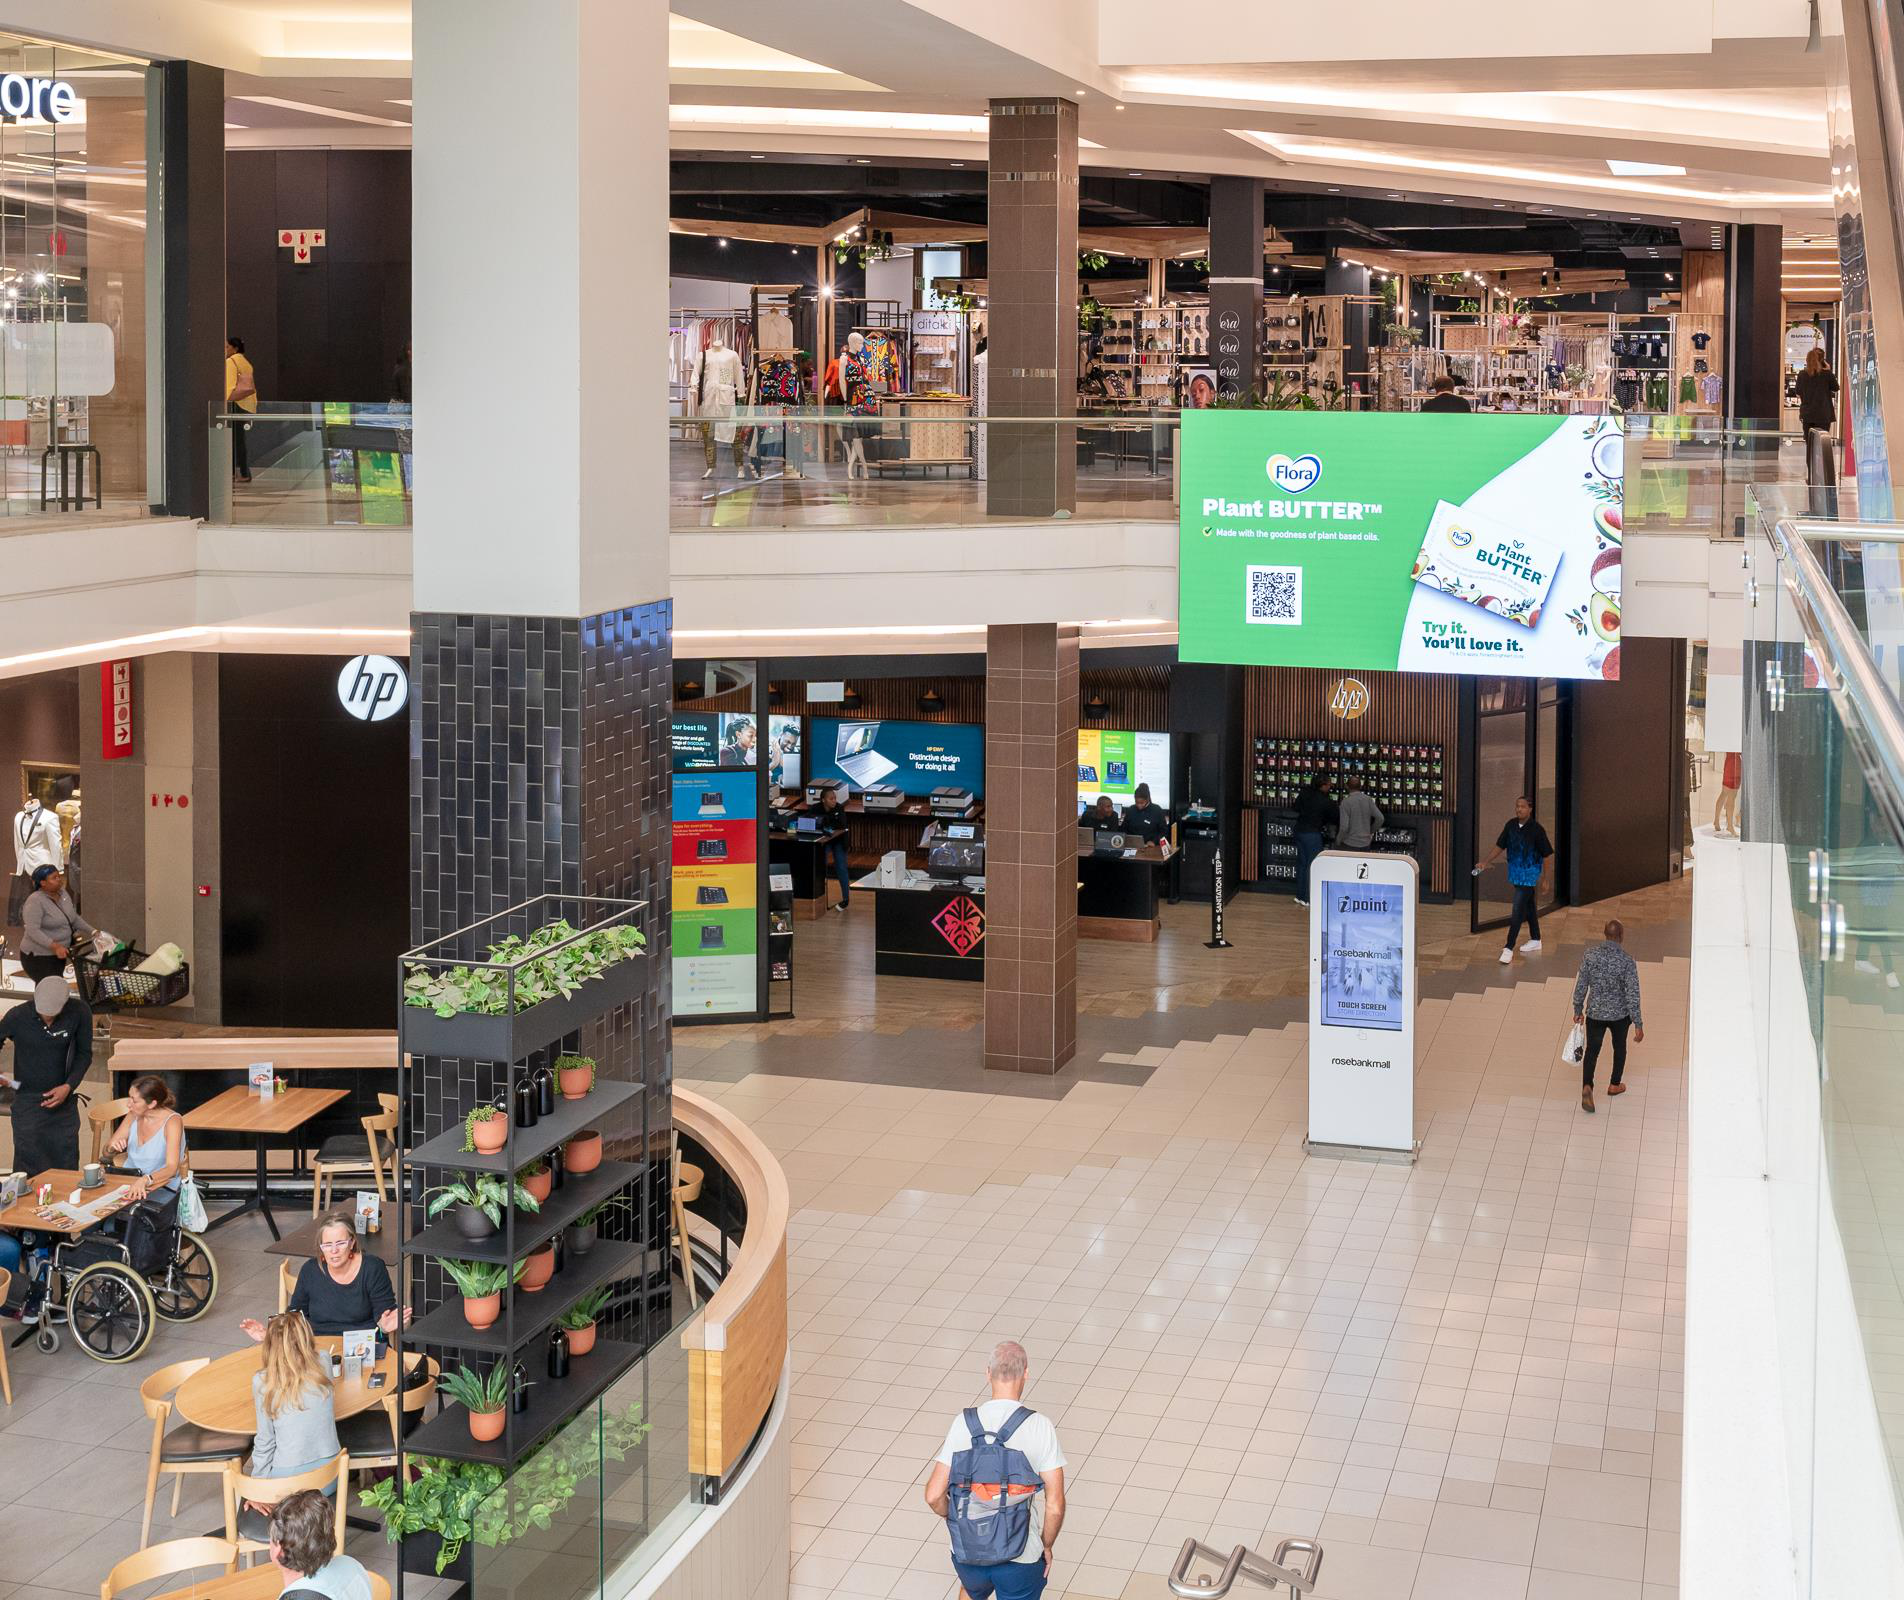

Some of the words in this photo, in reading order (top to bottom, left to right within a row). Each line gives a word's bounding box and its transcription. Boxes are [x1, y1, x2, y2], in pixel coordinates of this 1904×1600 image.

[0, 74, 76, 123] ore
[1220, 319, 1238, 329] era
[1220, 342, 1238, 353] era
[1220, 366, 1238, 377] era
[1276, 465, 1313, 480] Flora
[1202, 498, 1264, 517] Plant
[1216, 528, 1236, 537] Made
[1238, 528, 1255, 537] with
[1256, 529, 1268, 538] the
[1270, 530, 1307, 540] goodness
[1308, 530, 1316, 539] of
[1318, 531, 1337, 541] plant
[1339, 532, 1362, 541] based
[1363, 532, 1380, 542] oils.
[1452, 531, 1468, 543] Flora
[1496, 543, 1532, 565] Plant
[1422, 621, 1447, 636] Try
[1451, 621, 1467, 634] it.
[1422, 636, 1466, 649] You’ll
[1470, 637, 1503, 650] love
[1506, 639, 1523, 652] it.
[348, 655, 399, 721] hp
[1331, 679, 1364, 718] hp
[909, 753, 939, 761] Distinctive
[940, 754, 960, 763] design
[915, 762, 924, 770] for
[925, 763, 942, 772] doing
[1333, 949, 1392, 960] rosebankmall
[1338, 1001, 1359, 1009] TOUCH
[1361, 1003, 1387, 1011] SCREEN
[1331, 1057, 1391, 1069] rosebankmall
